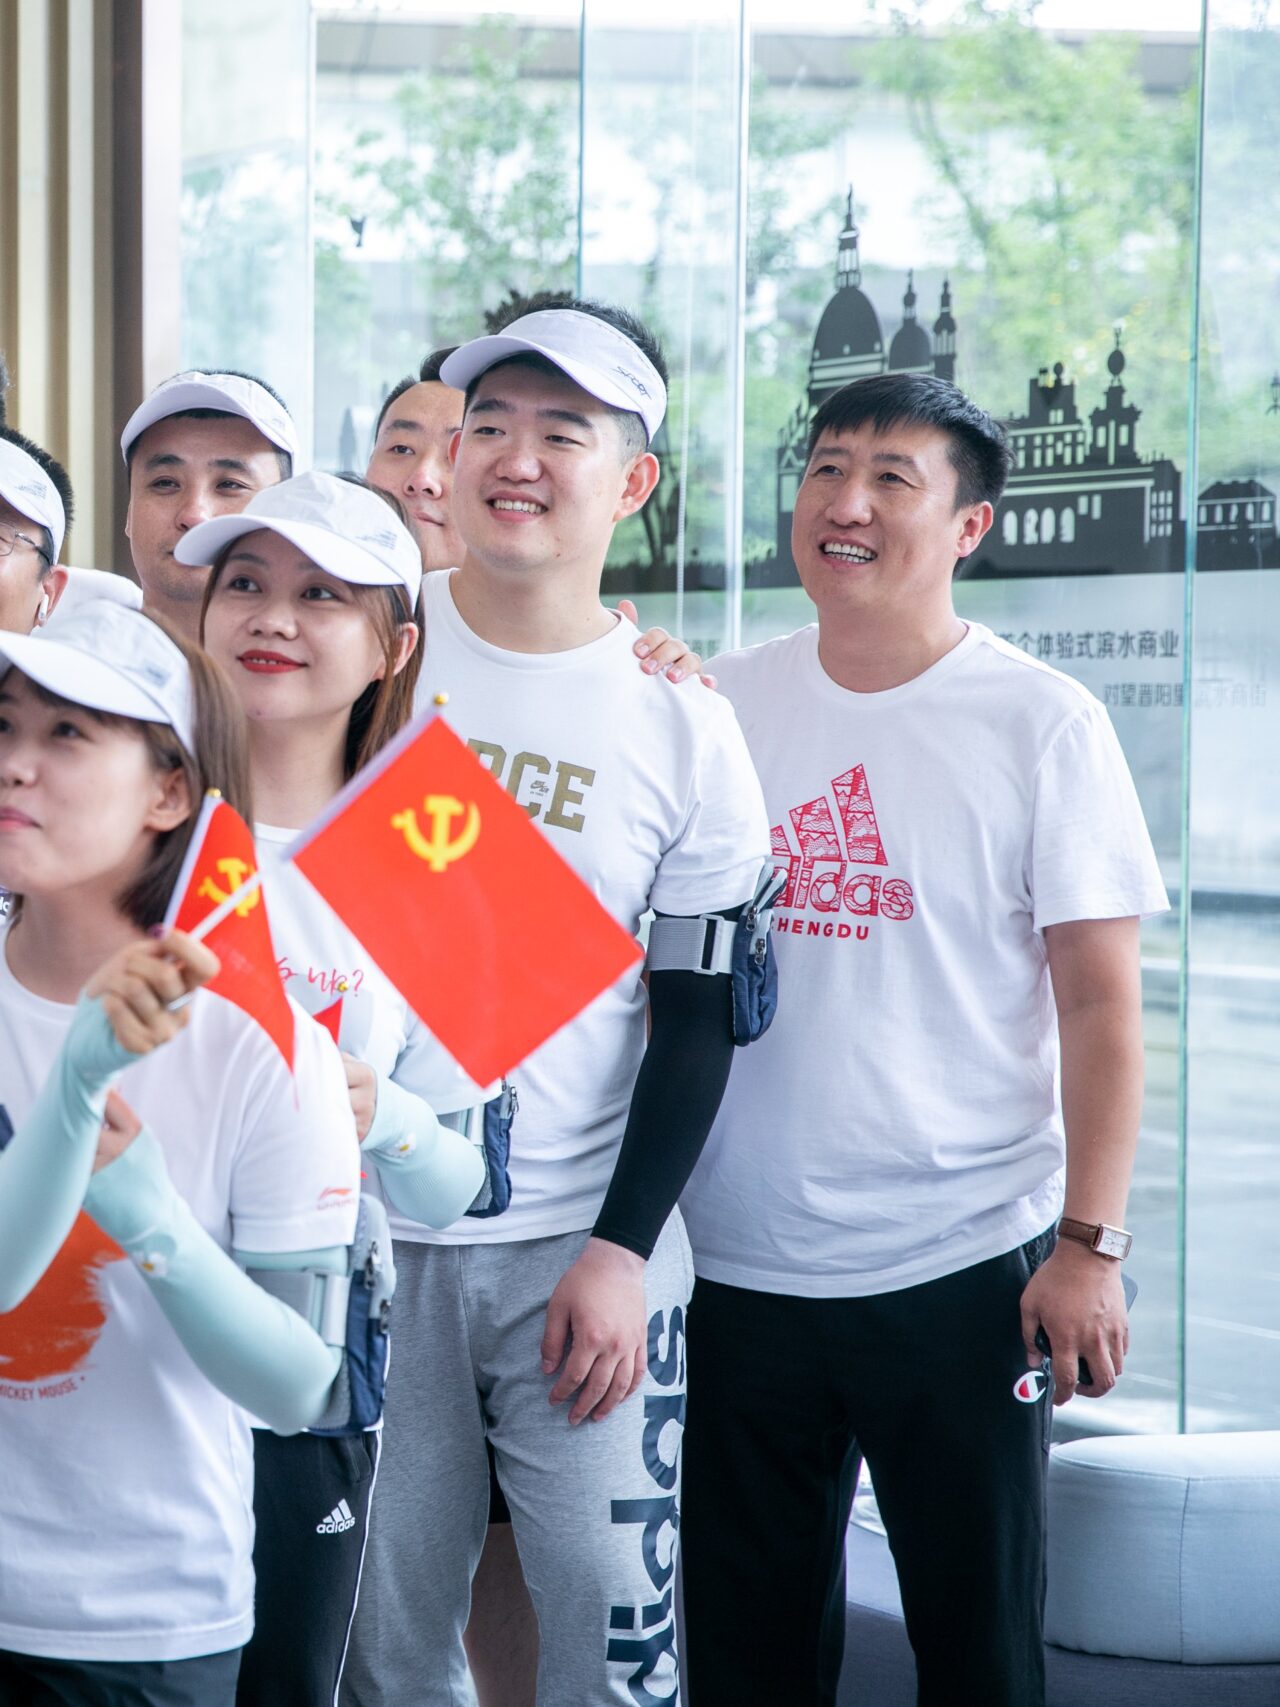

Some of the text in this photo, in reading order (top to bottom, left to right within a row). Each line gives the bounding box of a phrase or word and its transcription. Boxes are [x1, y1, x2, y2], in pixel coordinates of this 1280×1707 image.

[771, 917, 869, 941] HENGDU
[38, 1378, 78, 1399] MOUSE
[316, 1516, 356, 1534] adidas
